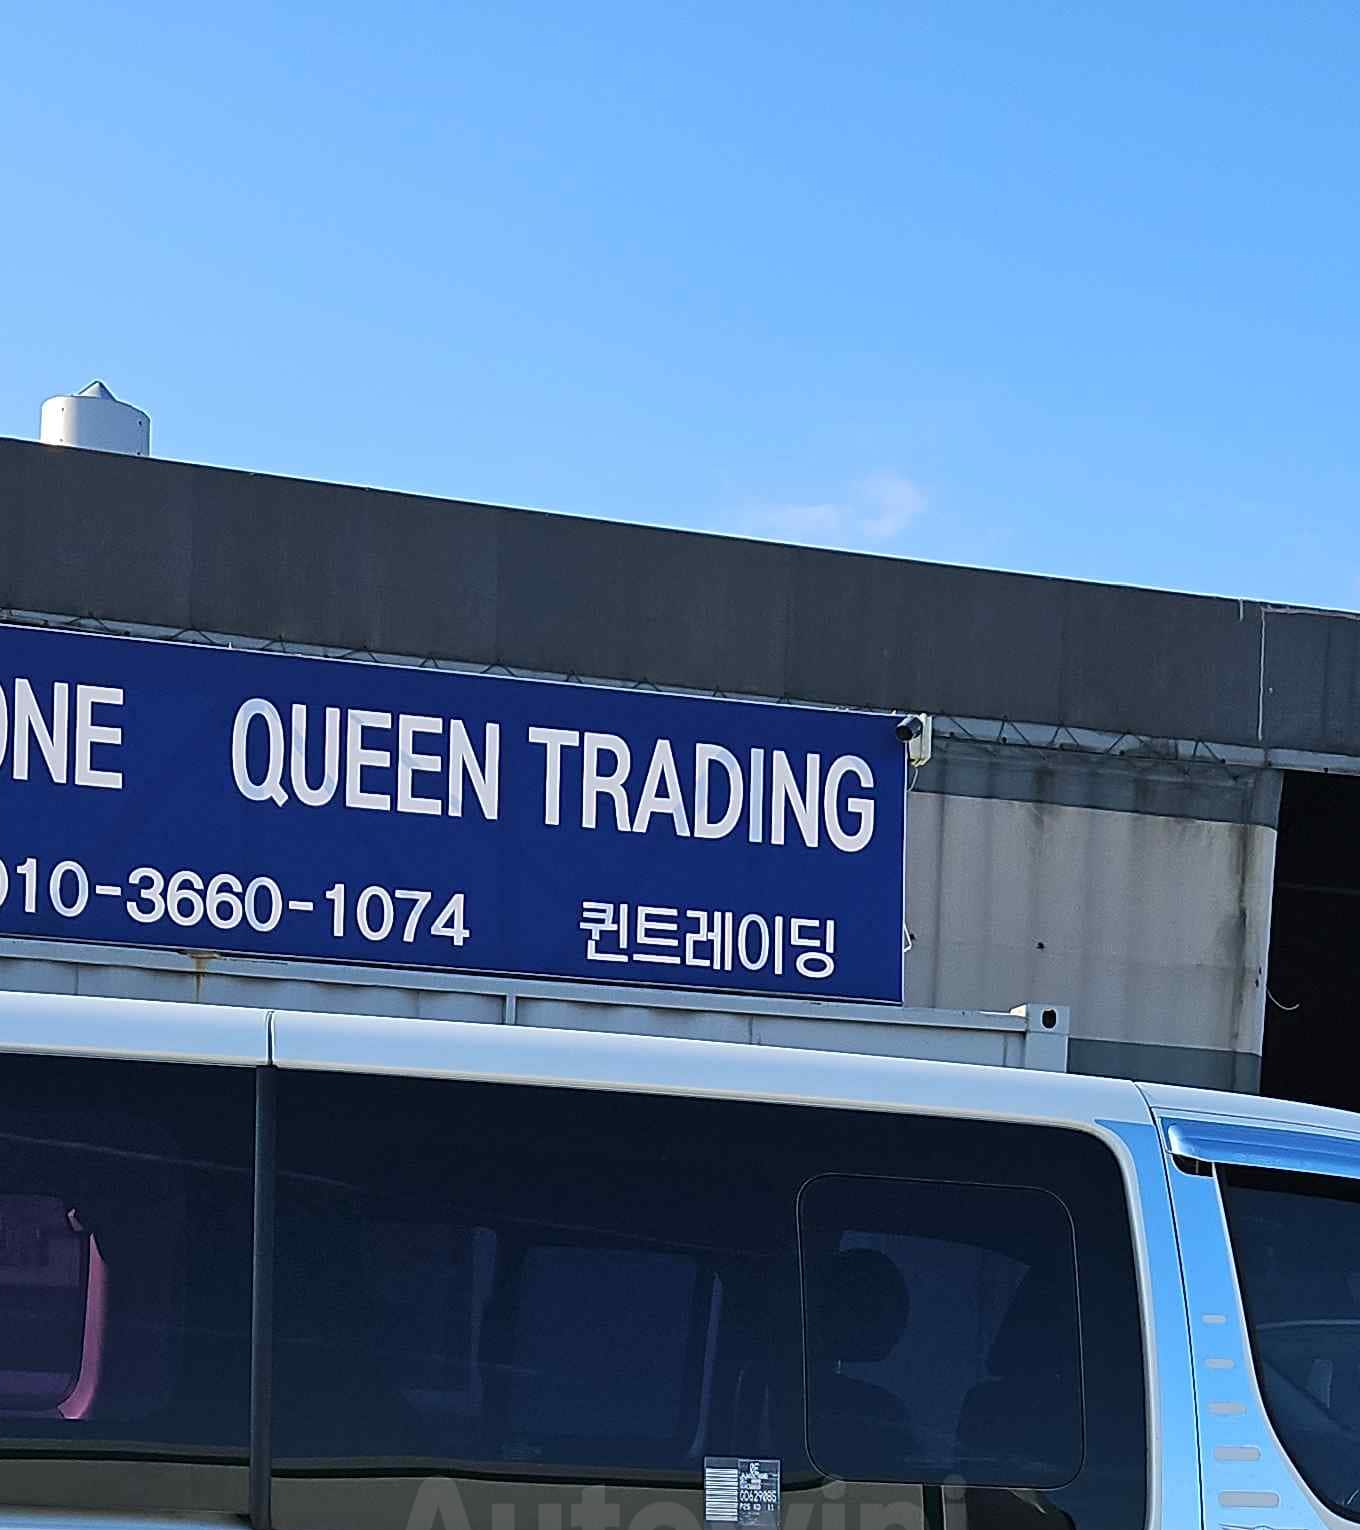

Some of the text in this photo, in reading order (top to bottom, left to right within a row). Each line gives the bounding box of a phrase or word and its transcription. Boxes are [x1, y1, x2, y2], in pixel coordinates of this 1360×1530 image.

[231, 698, 875, 853] QUEEN TRADING
[579, 901, 835, 978] 퀸트레이딩
